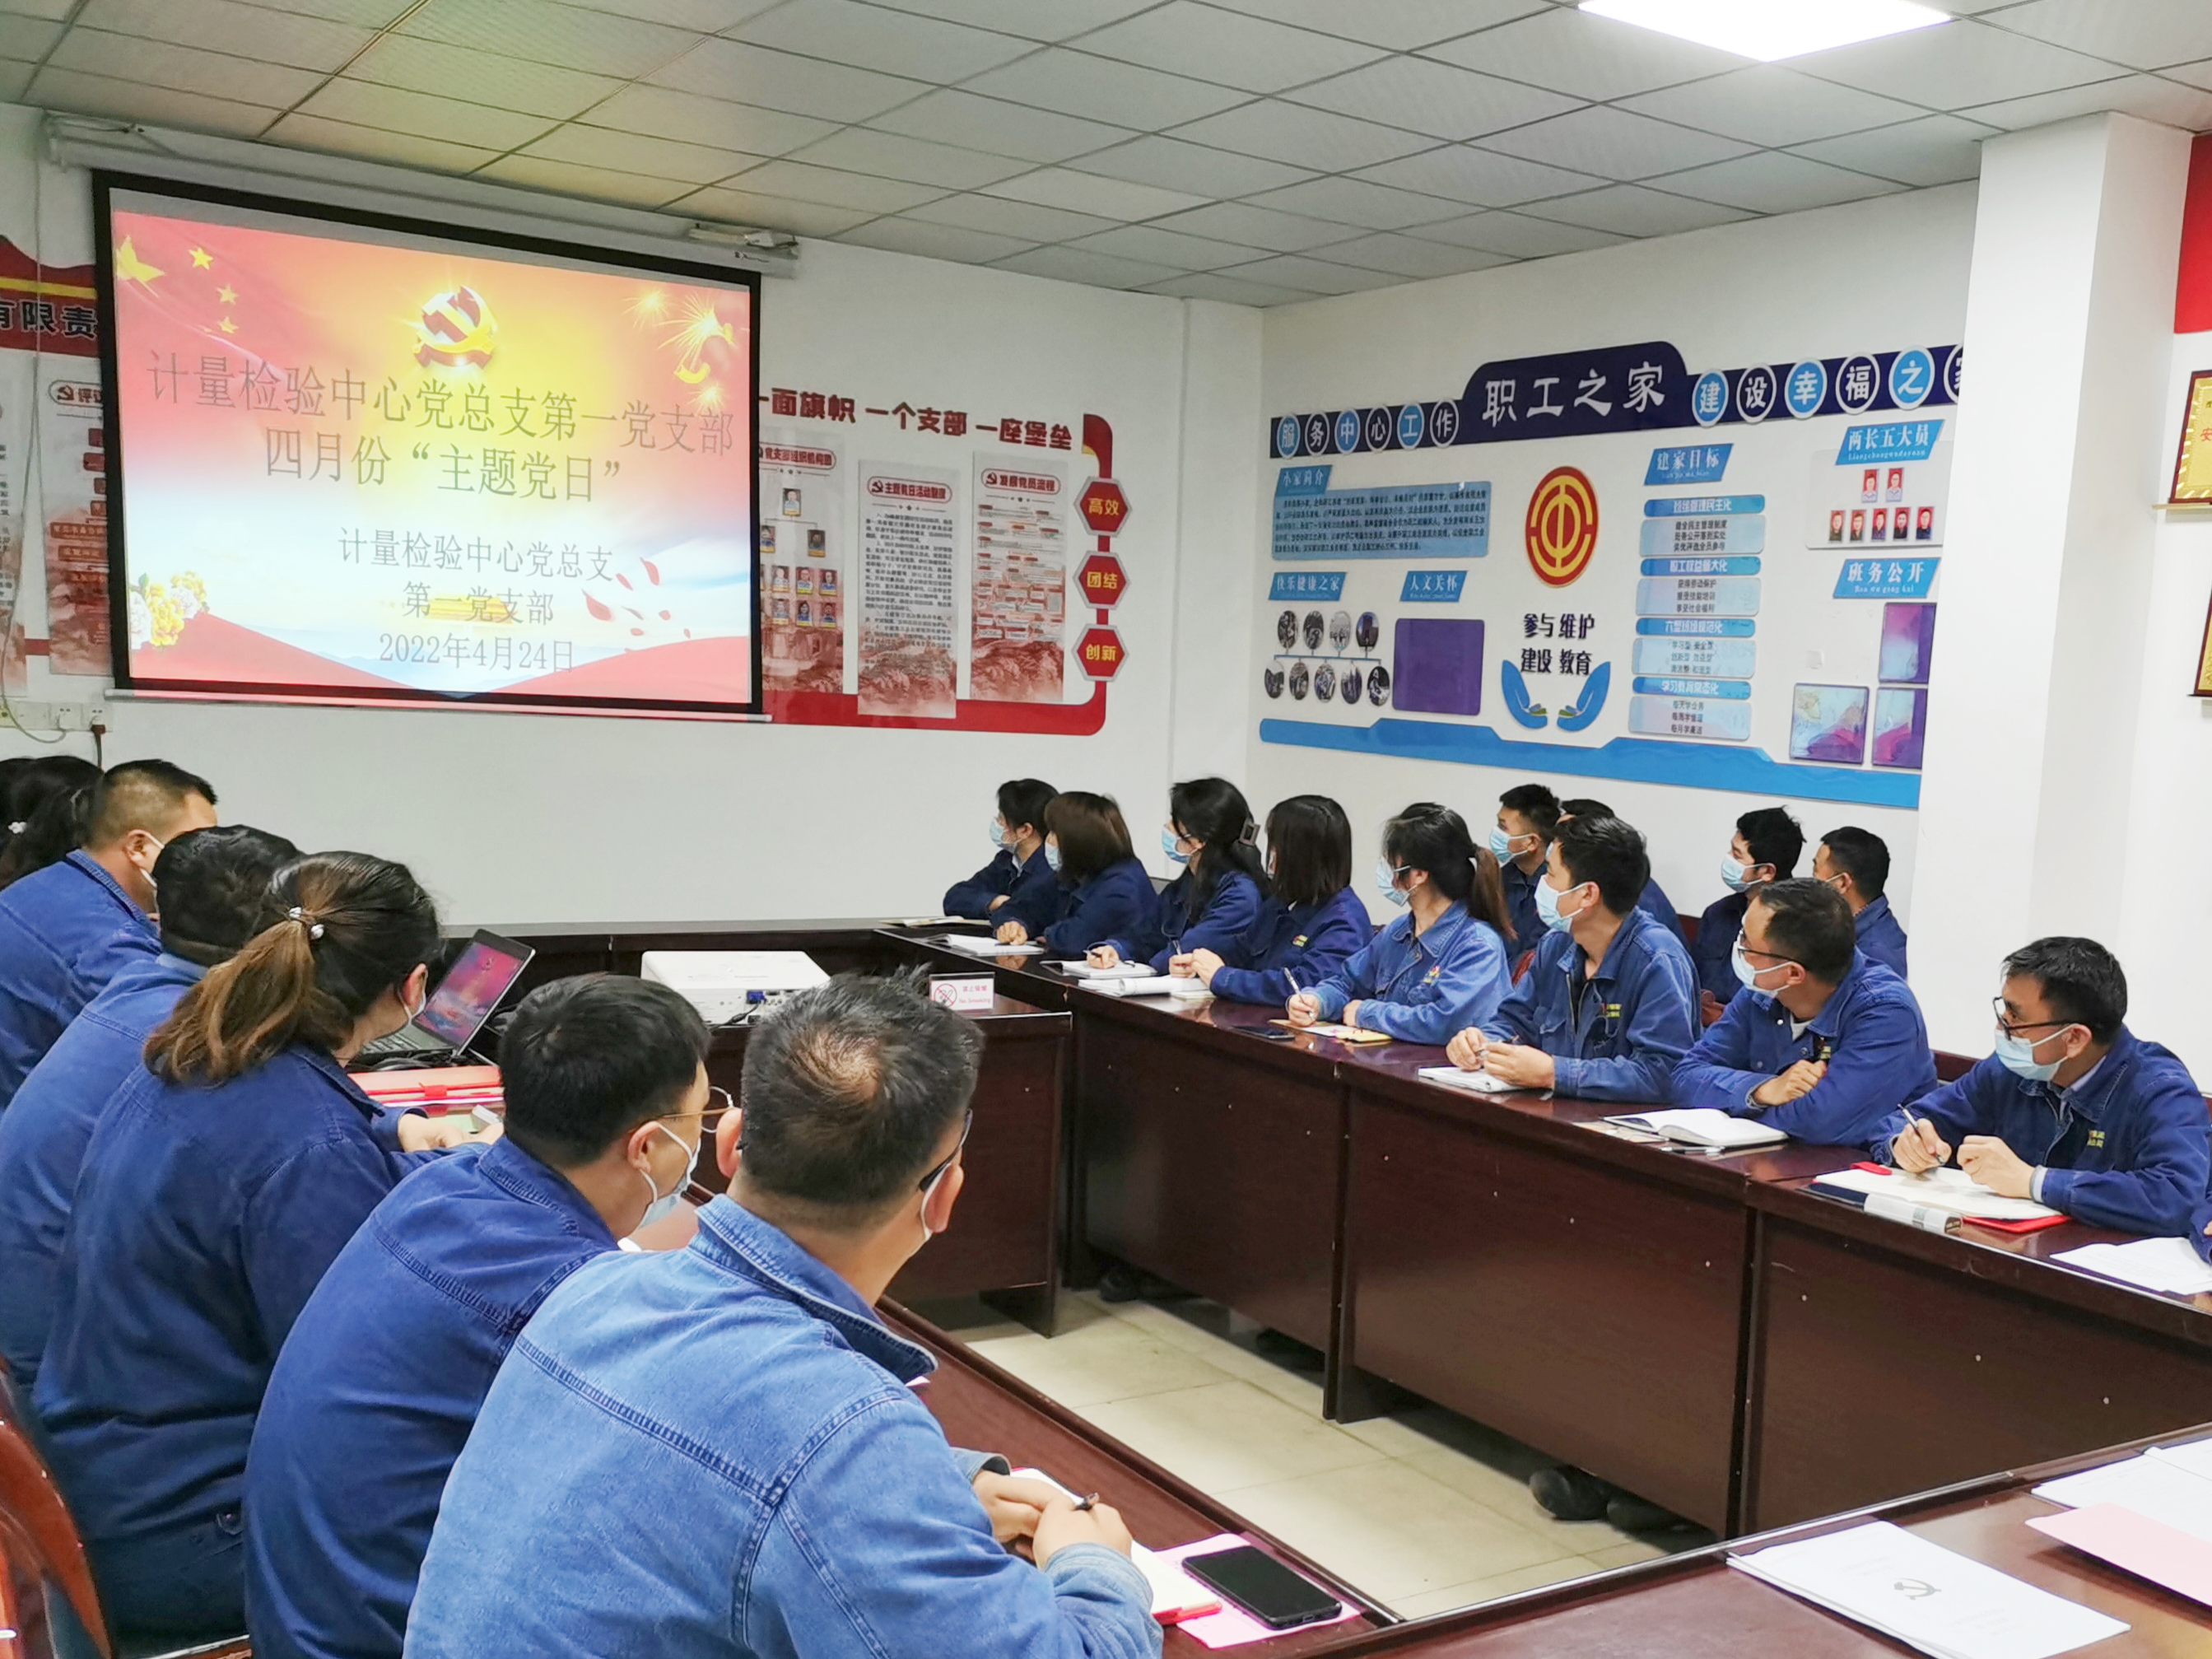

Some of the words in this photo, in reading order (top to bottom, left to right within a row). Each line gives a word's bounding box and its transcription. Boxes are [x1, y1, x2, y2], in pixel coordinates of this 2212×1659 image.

[147, 352, 734, 456] 计量检验中心党总支第一党支部
[1482, 361, 1665, 427] 职工之家
[865, 401, 967, 436] 一个支部
[976, 418, 1072, 450] 一座堡垒
[1281, 409, 1454, 448] 服务中心工作
[1848, 423, 1929, 451] 两长五大员
[1657, 447, 1720, 471] 建家目标
[1087, 497, 1120, 515] 高效
[338, 527, 613, 582] 计量检验中心党总支
[1087, 571, 1118, 589] 团结
[1410, 575, 1458, 591] 人文关怀
[1847, 561, 1925, 584] 班务公开
[403, 581, 554, 625] 第一党支部
[1523, 613, 1555, 638] 参与
[1558, 613, 1595, 639] 维护
[380, 632, 573, 673] 2022年4月24日
[1086, 644, 1116, 661] 创新
[1520, 647, 1553, 673] 建设
[1560, 648, 1593, 676] 教育
